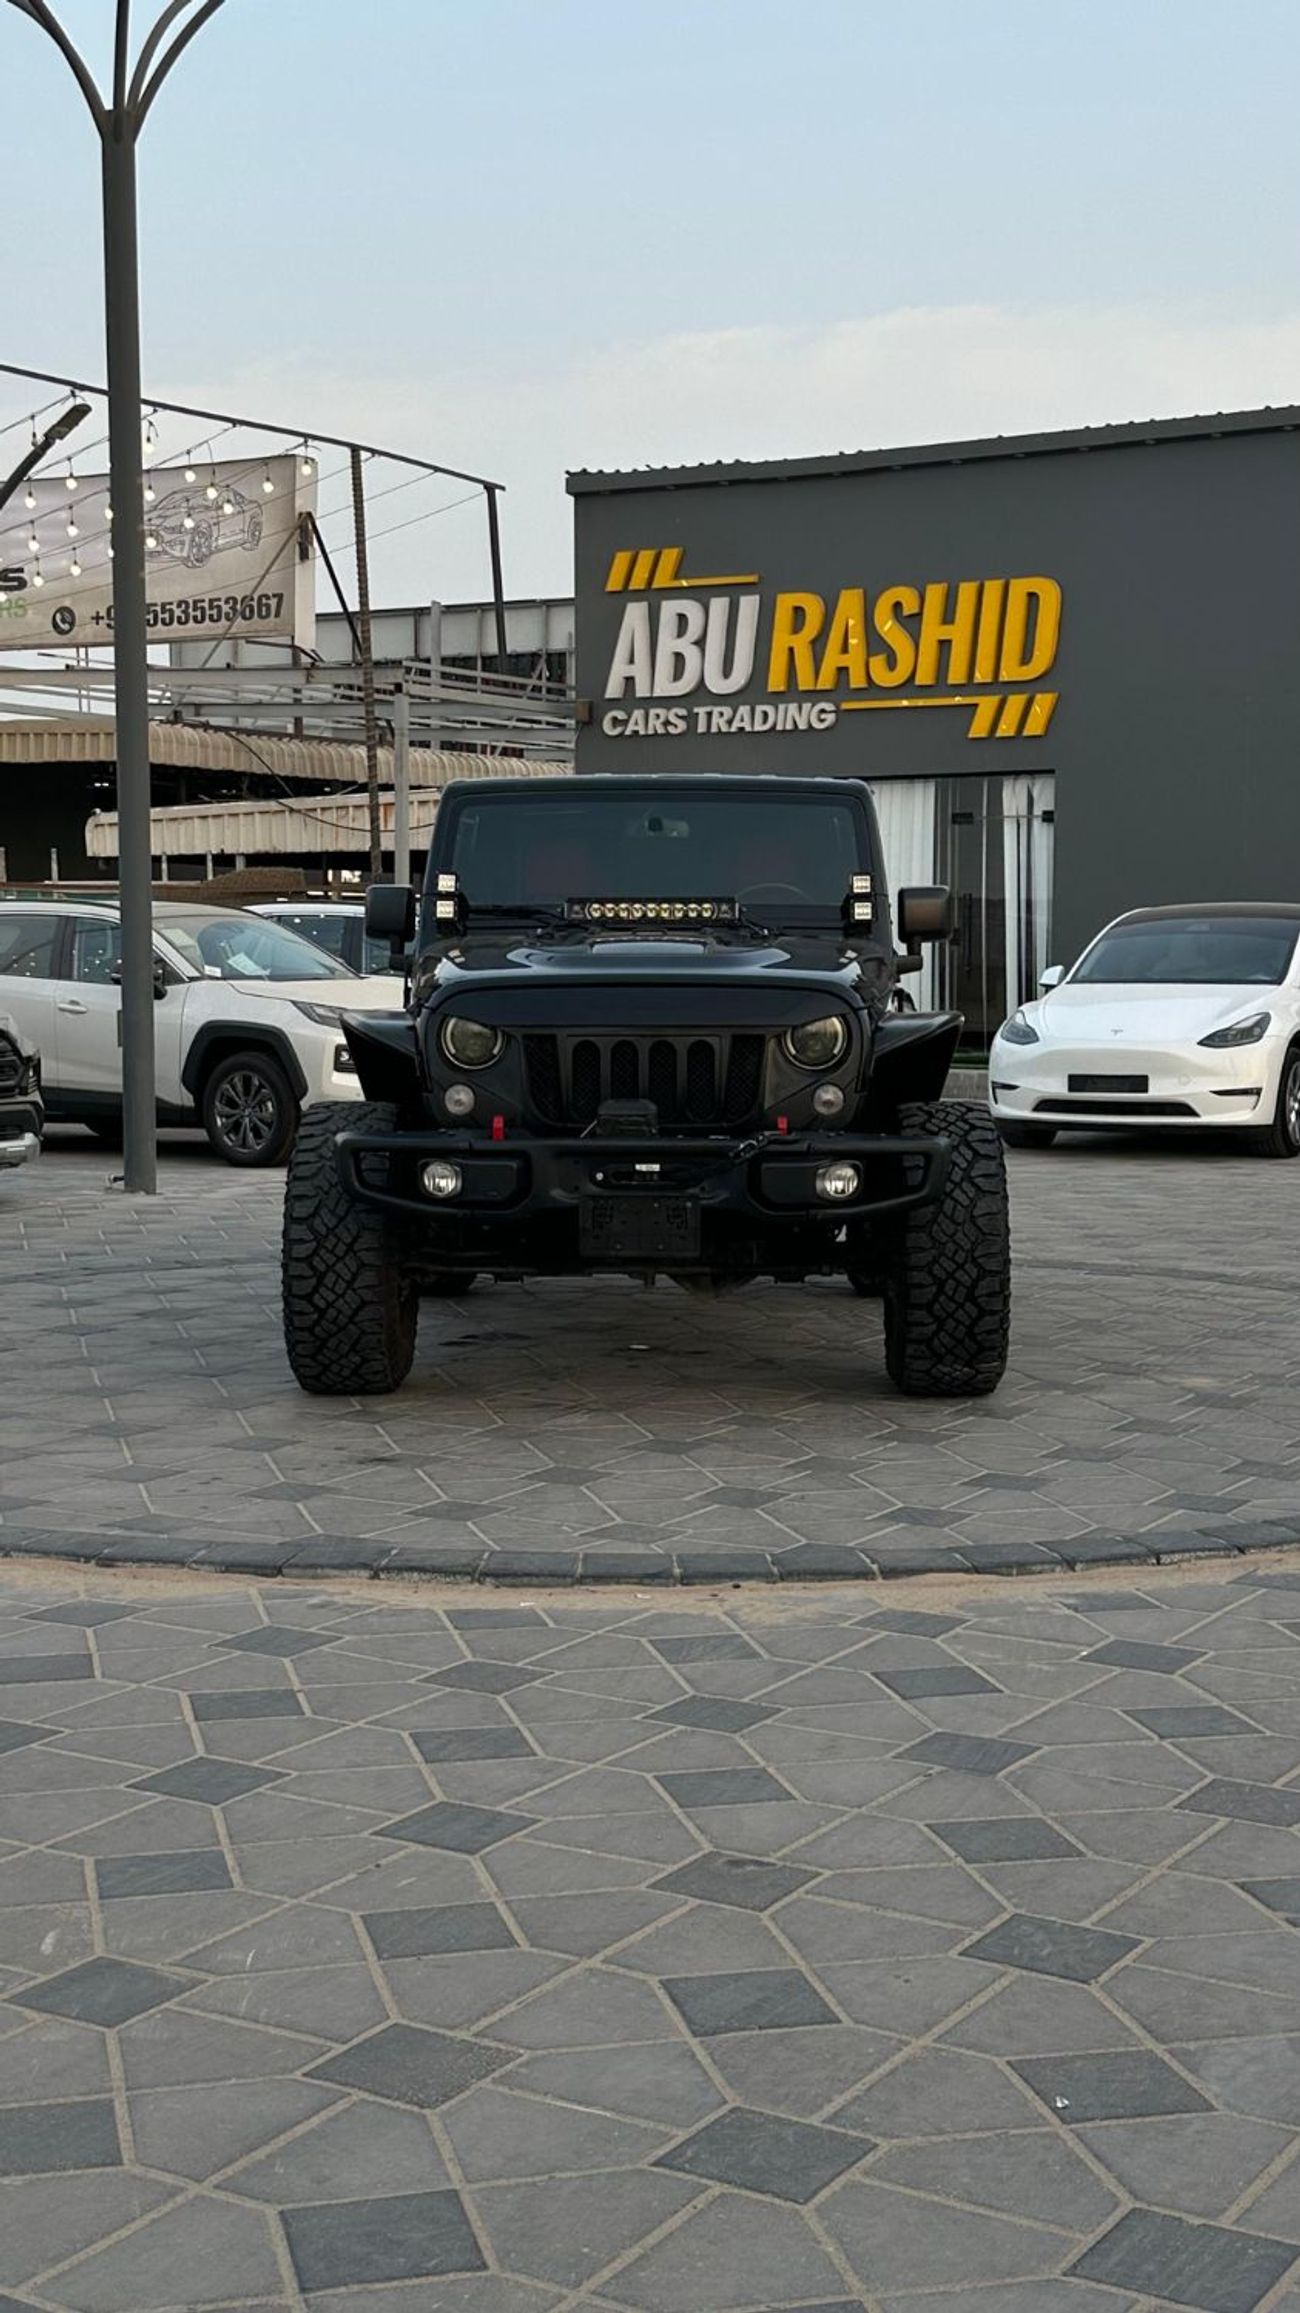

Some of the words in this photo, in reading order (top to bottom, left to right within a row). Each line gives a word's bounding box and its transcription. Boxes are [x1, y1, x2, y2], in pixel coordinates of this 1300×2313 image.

[91, 593, 284, 630] +9553553667
[604, 594, 761, 699] ABU
[767, 574, 1062, 693] RASHID
[602, 707, 687, 737] CARS
[694, 702, 837, 735] TRADING
